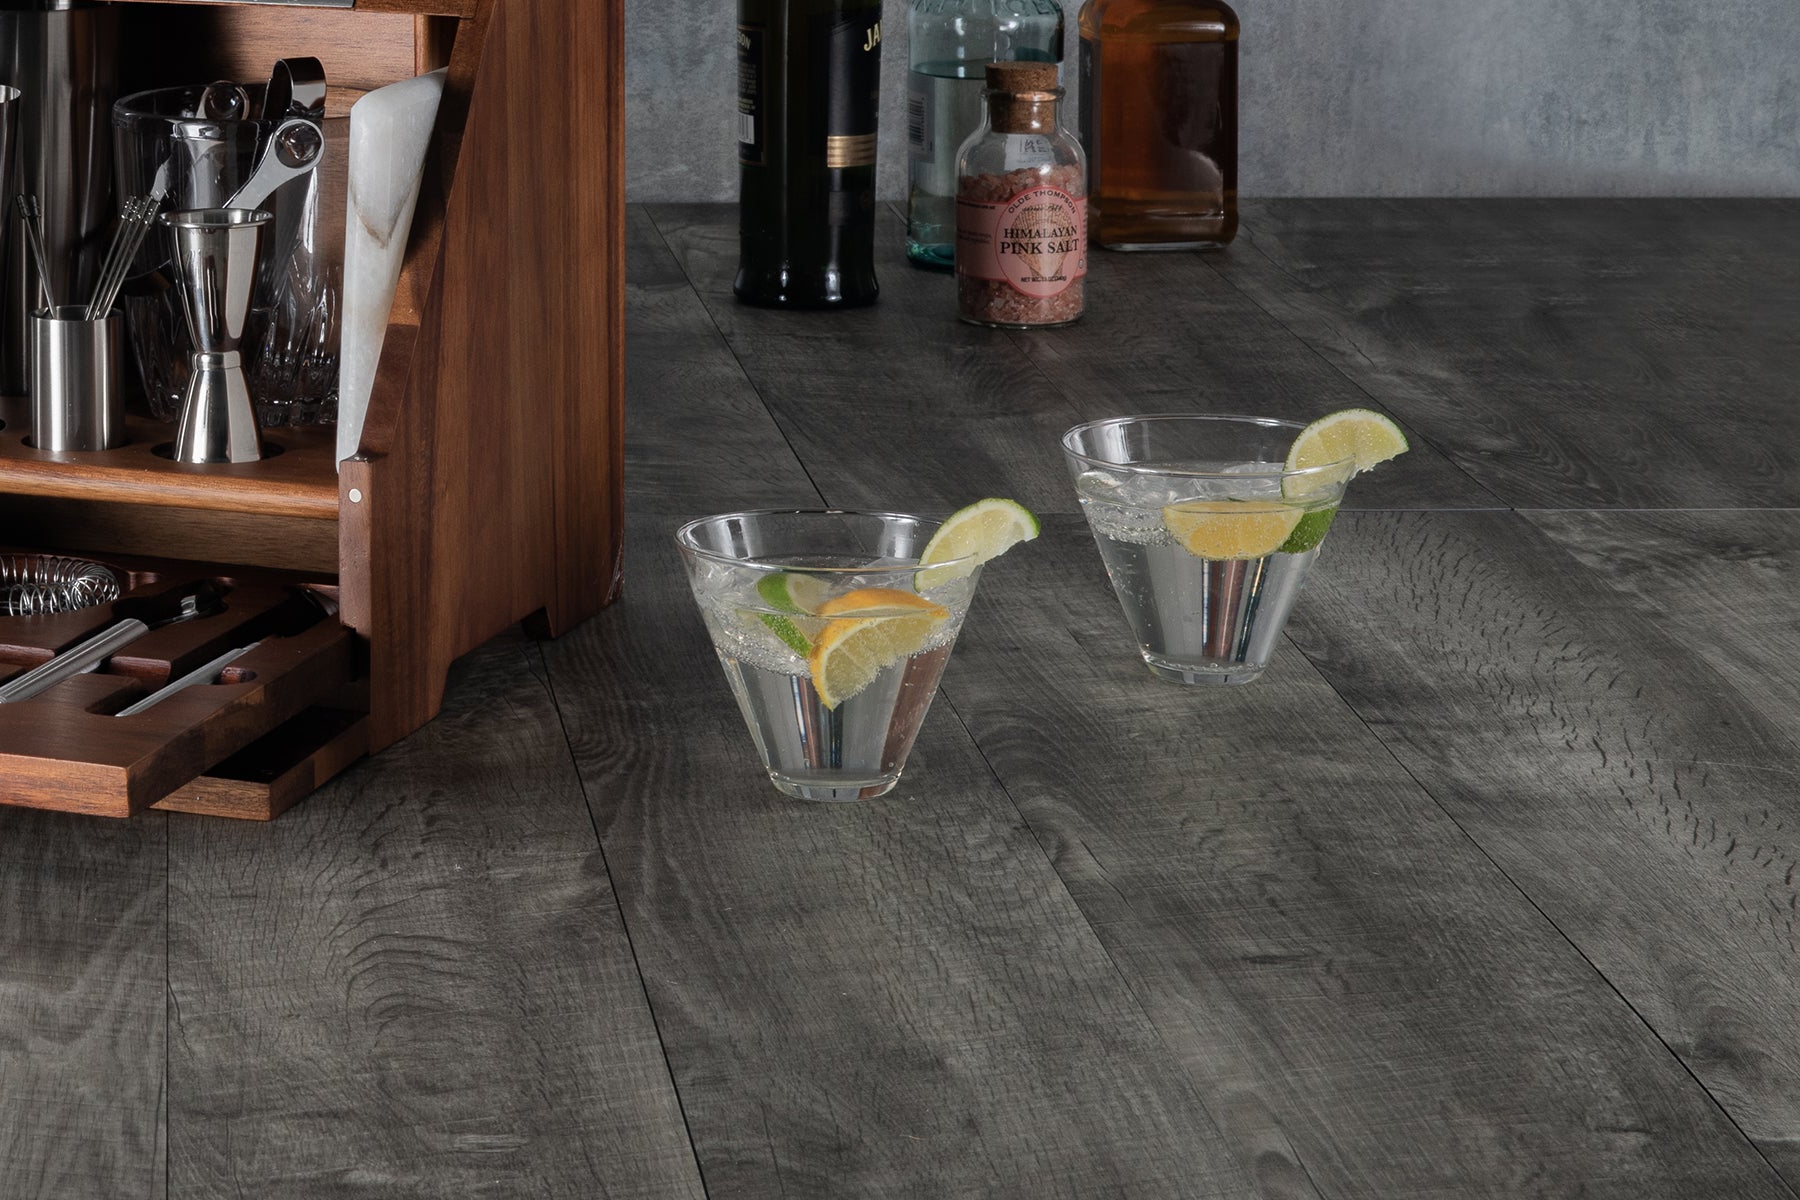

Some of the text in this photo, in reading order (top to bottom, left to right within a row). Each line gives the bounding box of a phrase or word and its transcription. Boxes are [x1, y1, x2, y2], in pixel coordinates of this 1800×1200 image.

[1008, 194, 1031, 214] OLDE
[1032, 190, 1077, 214] THOMPSON
[1004, 226, 1077, 239] HIMALAYAN
[1000, 238, 1079, 255] PINK SALT
